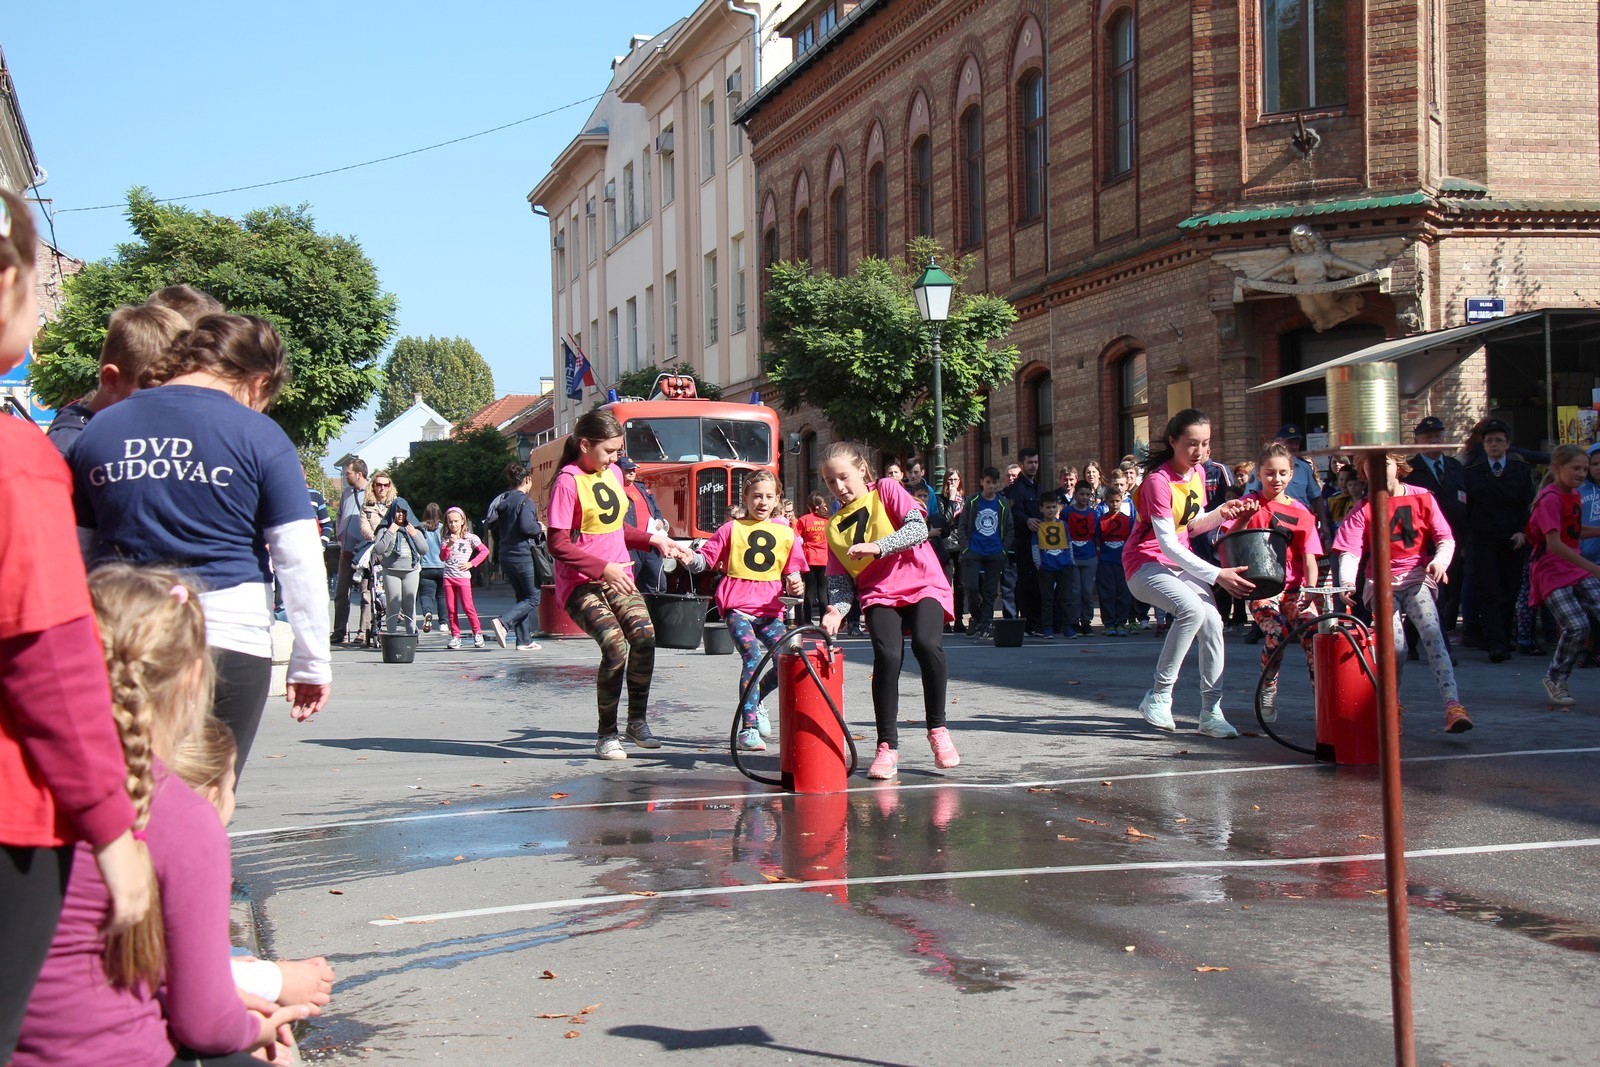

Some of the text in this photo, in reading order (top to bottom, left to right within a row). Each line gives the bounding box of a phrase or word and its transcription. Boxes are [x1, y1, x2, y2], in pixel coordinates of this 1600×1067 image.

[124, 437, 193, 459] DVD
[89, 458, 234, 487] GUDOVAC
[699, 482, 712, 495] FAP
[592, 482, 620, 525] 9
[1179, 489, 1200, 526] 6
[836, 506, 870, 560] 7
[1045, 525, 1061, 546] 8
[1075, 517, 1089, 538] 3
[1106, 518, 1123, 539] 2
[1389, 505, 1419, 549] 4
[1567, 503, 1582, 540] 3
[743, 529, 777, 573] 8
